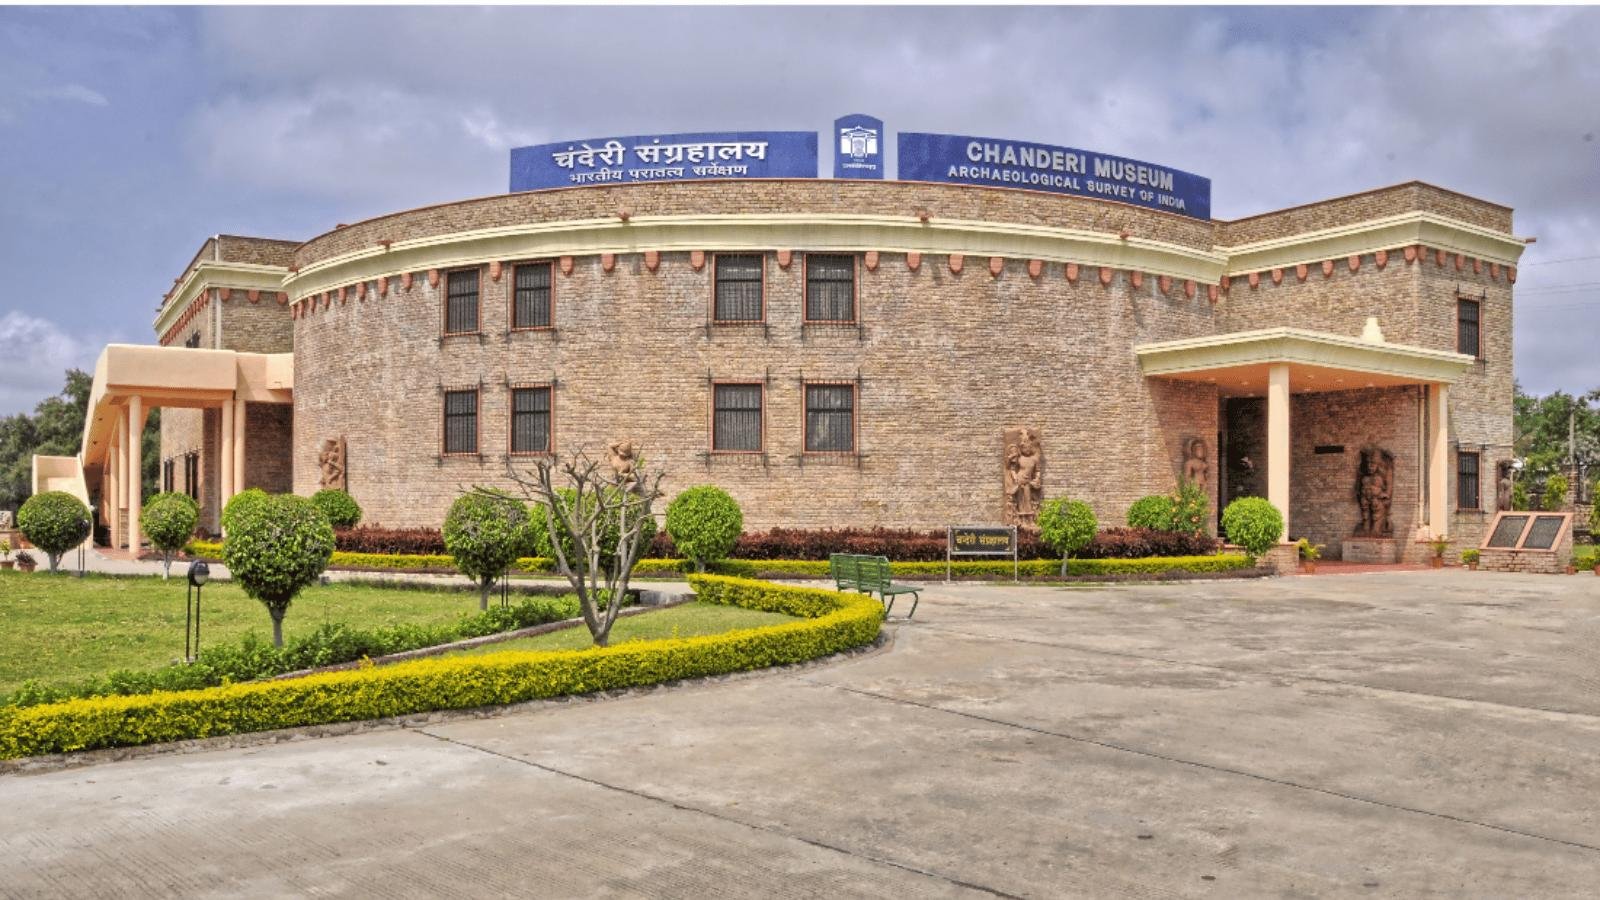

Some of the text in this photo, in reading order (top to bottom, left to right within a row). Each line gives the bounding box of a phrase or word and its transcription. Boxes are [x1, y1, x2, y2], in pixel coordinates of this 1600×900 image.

[553, 138, 768, 168] चंदेरी संग्रहालय
[570, 167, 623, 183] भारतीय
[692, 161, 748, 176] सर्वेक्षण
[966, 141, 1174, 191] CHANDERI MUSEUM
[948, 165, 1186, 211] ARCHAEOLOGICAL SURVEY OF INDIA
